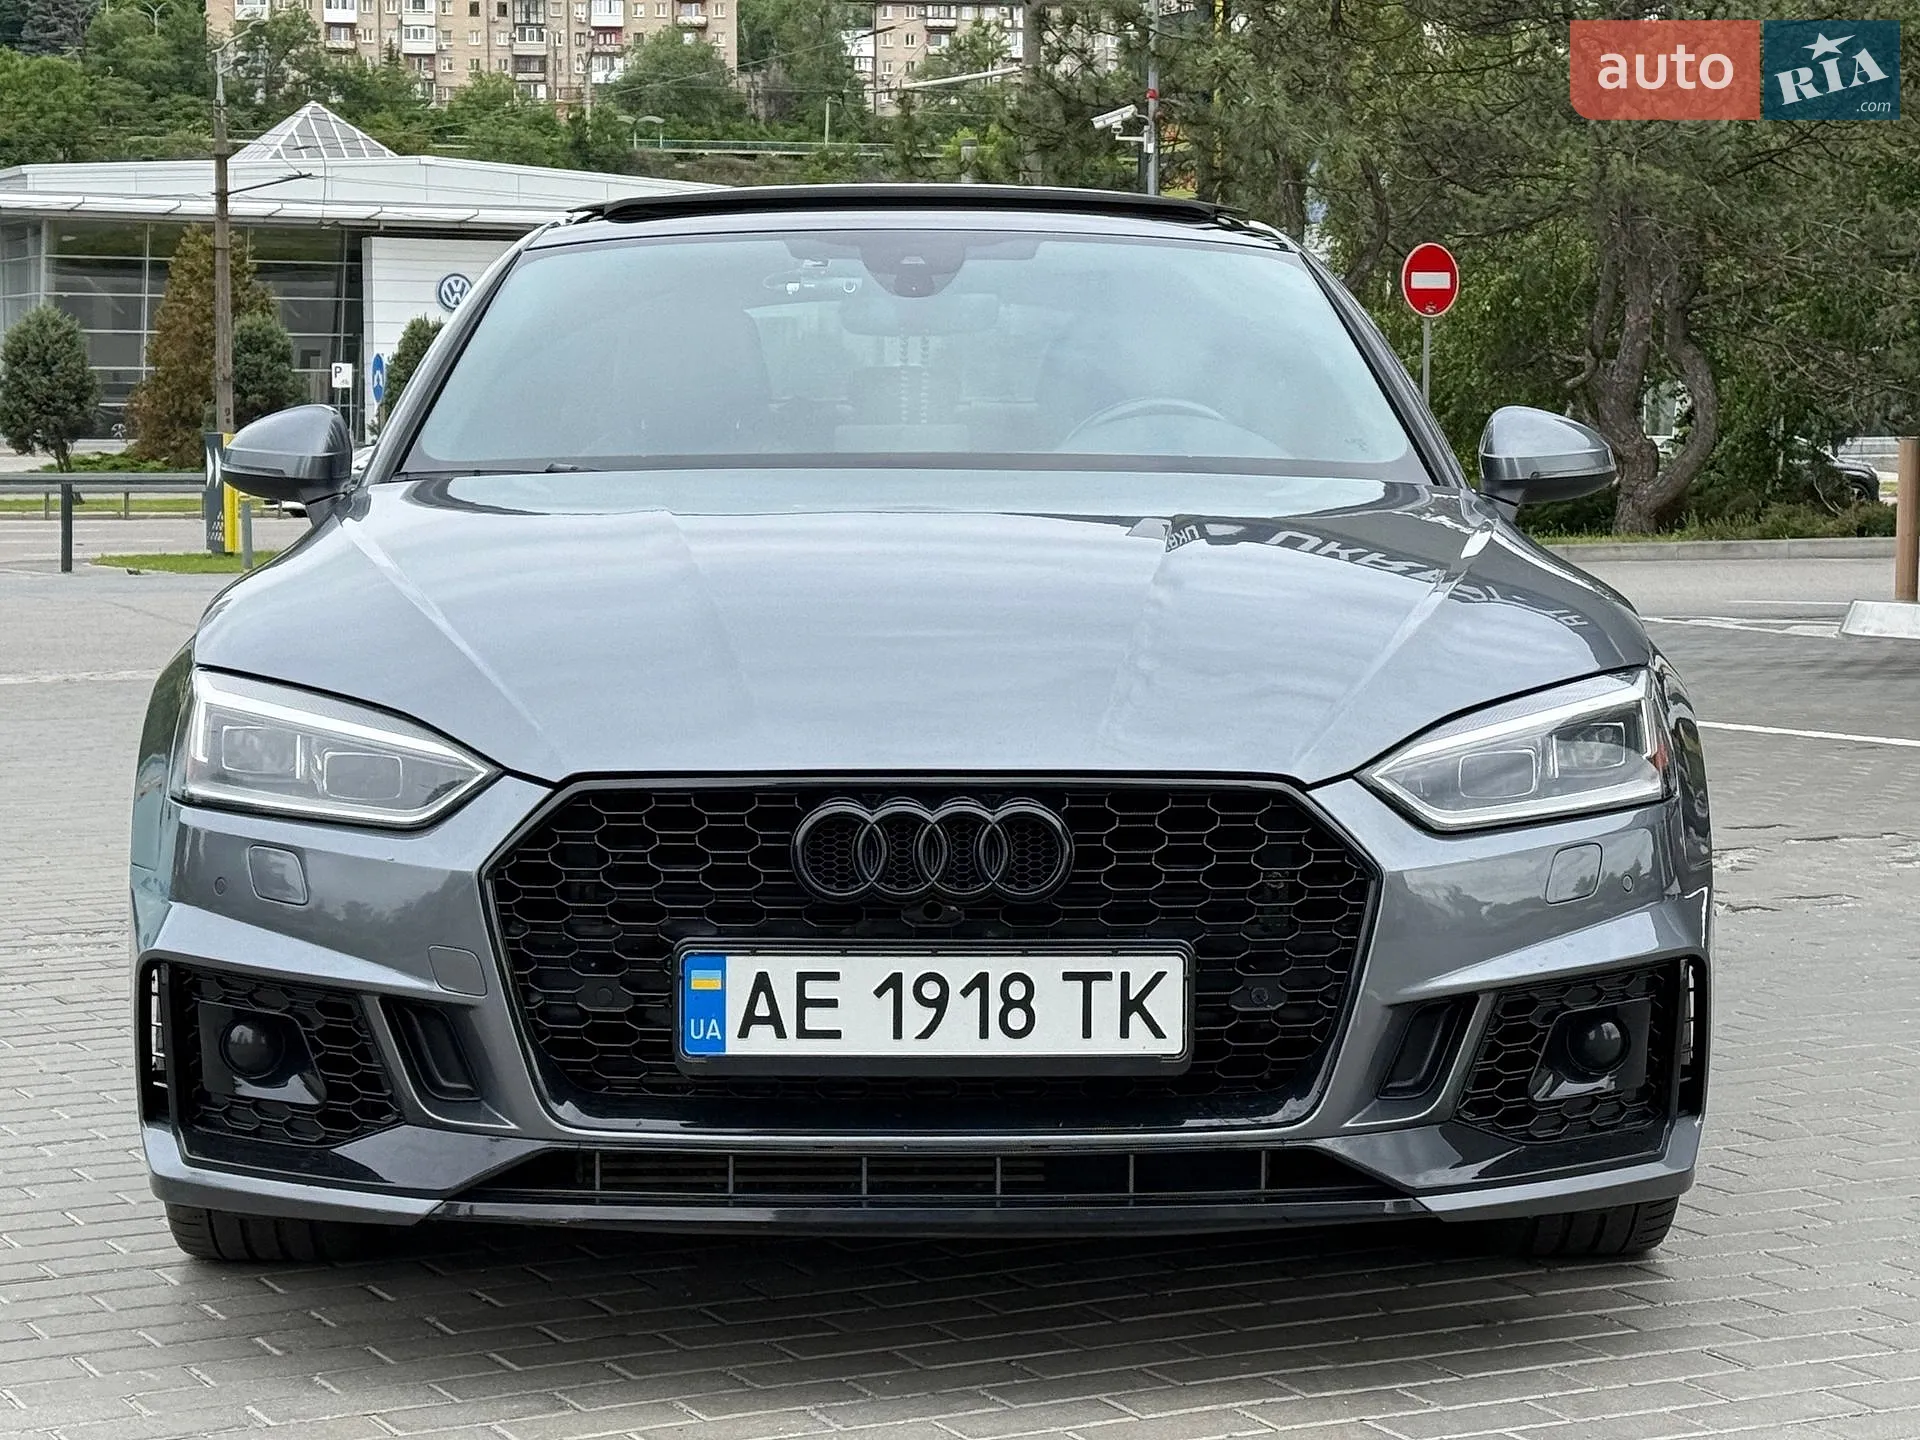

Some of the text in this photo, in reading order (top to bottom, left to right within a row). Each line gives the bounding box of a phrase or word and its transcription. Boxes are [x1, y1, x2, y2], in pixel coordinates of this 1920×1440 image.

[334, 365, 343, 378] P
[737, 971, 1168, 1040] AE 1918 TK
[690, 1017, 722, 1041] UA
